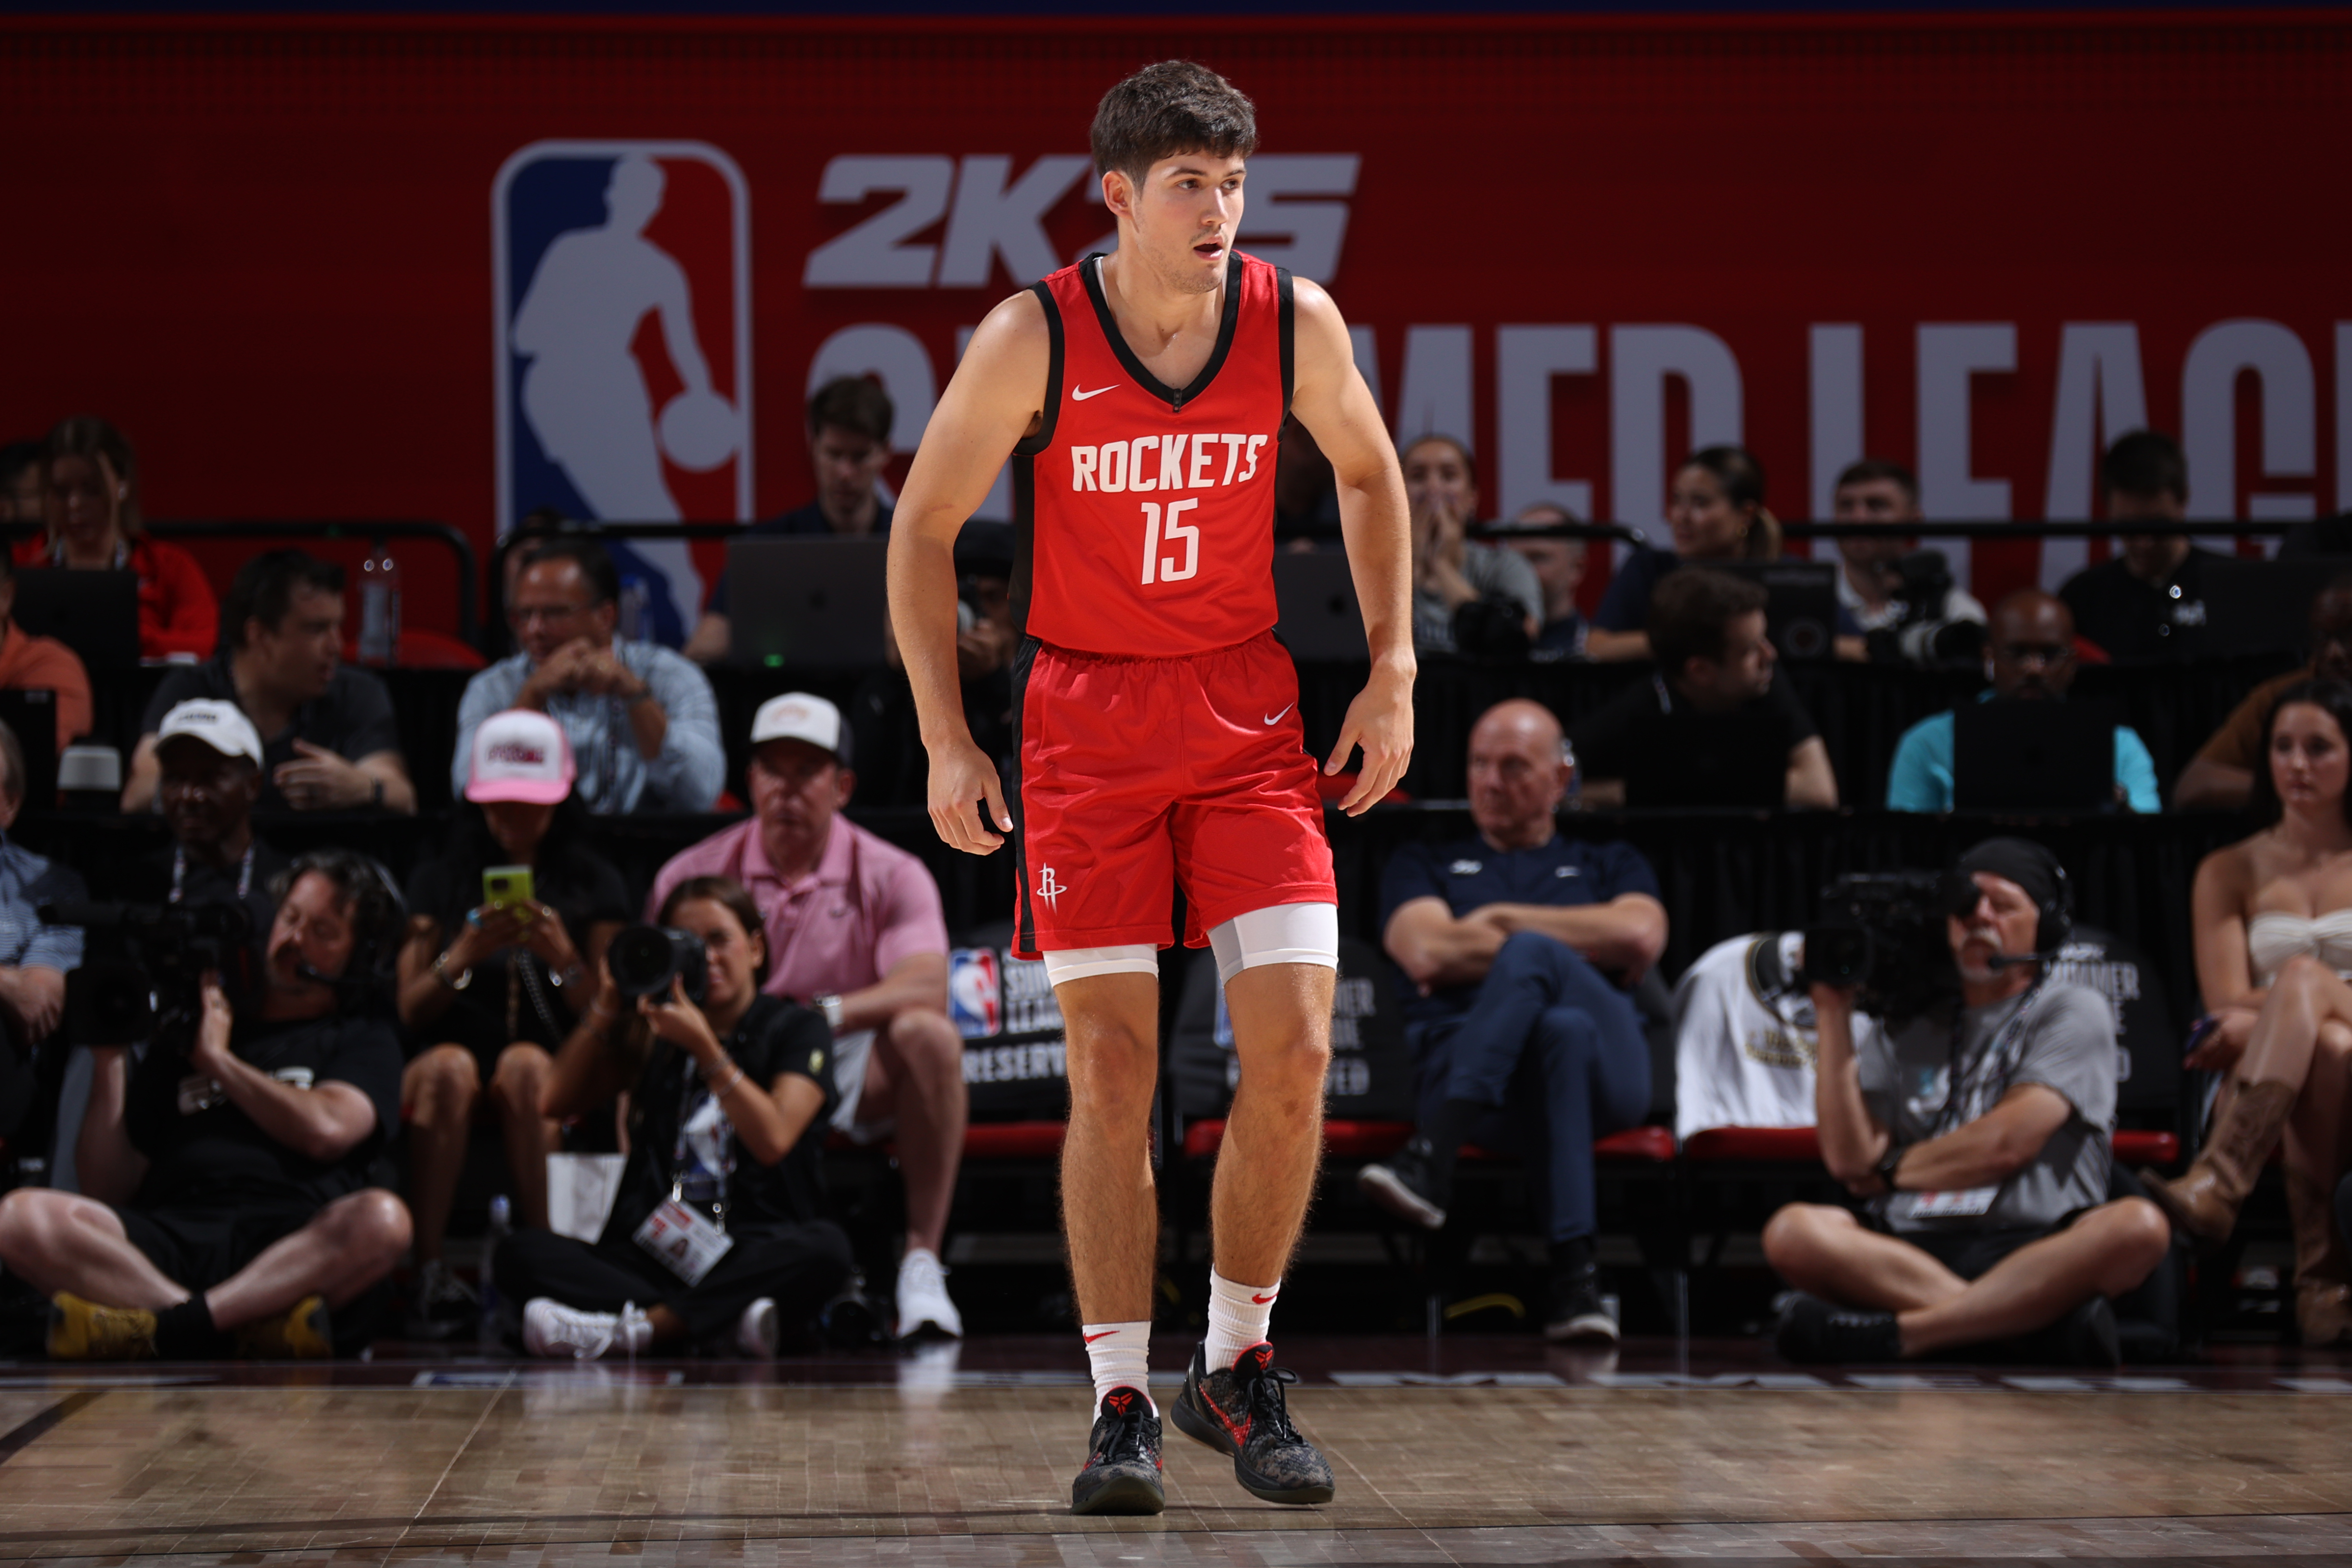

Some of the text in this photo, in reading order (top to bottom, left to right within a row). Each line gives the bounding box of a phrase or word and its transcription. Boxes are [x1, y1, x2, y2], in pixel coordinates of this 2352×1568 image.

[801, 152, 1363, 290] 2K5
[1071, 433, 1268, 493] ROCKETS
[1808, 315, 2352, 596] LEAG
[1141, 497, 1200, 585] 15
[960, 1041, 1067, 1084] RESERV
